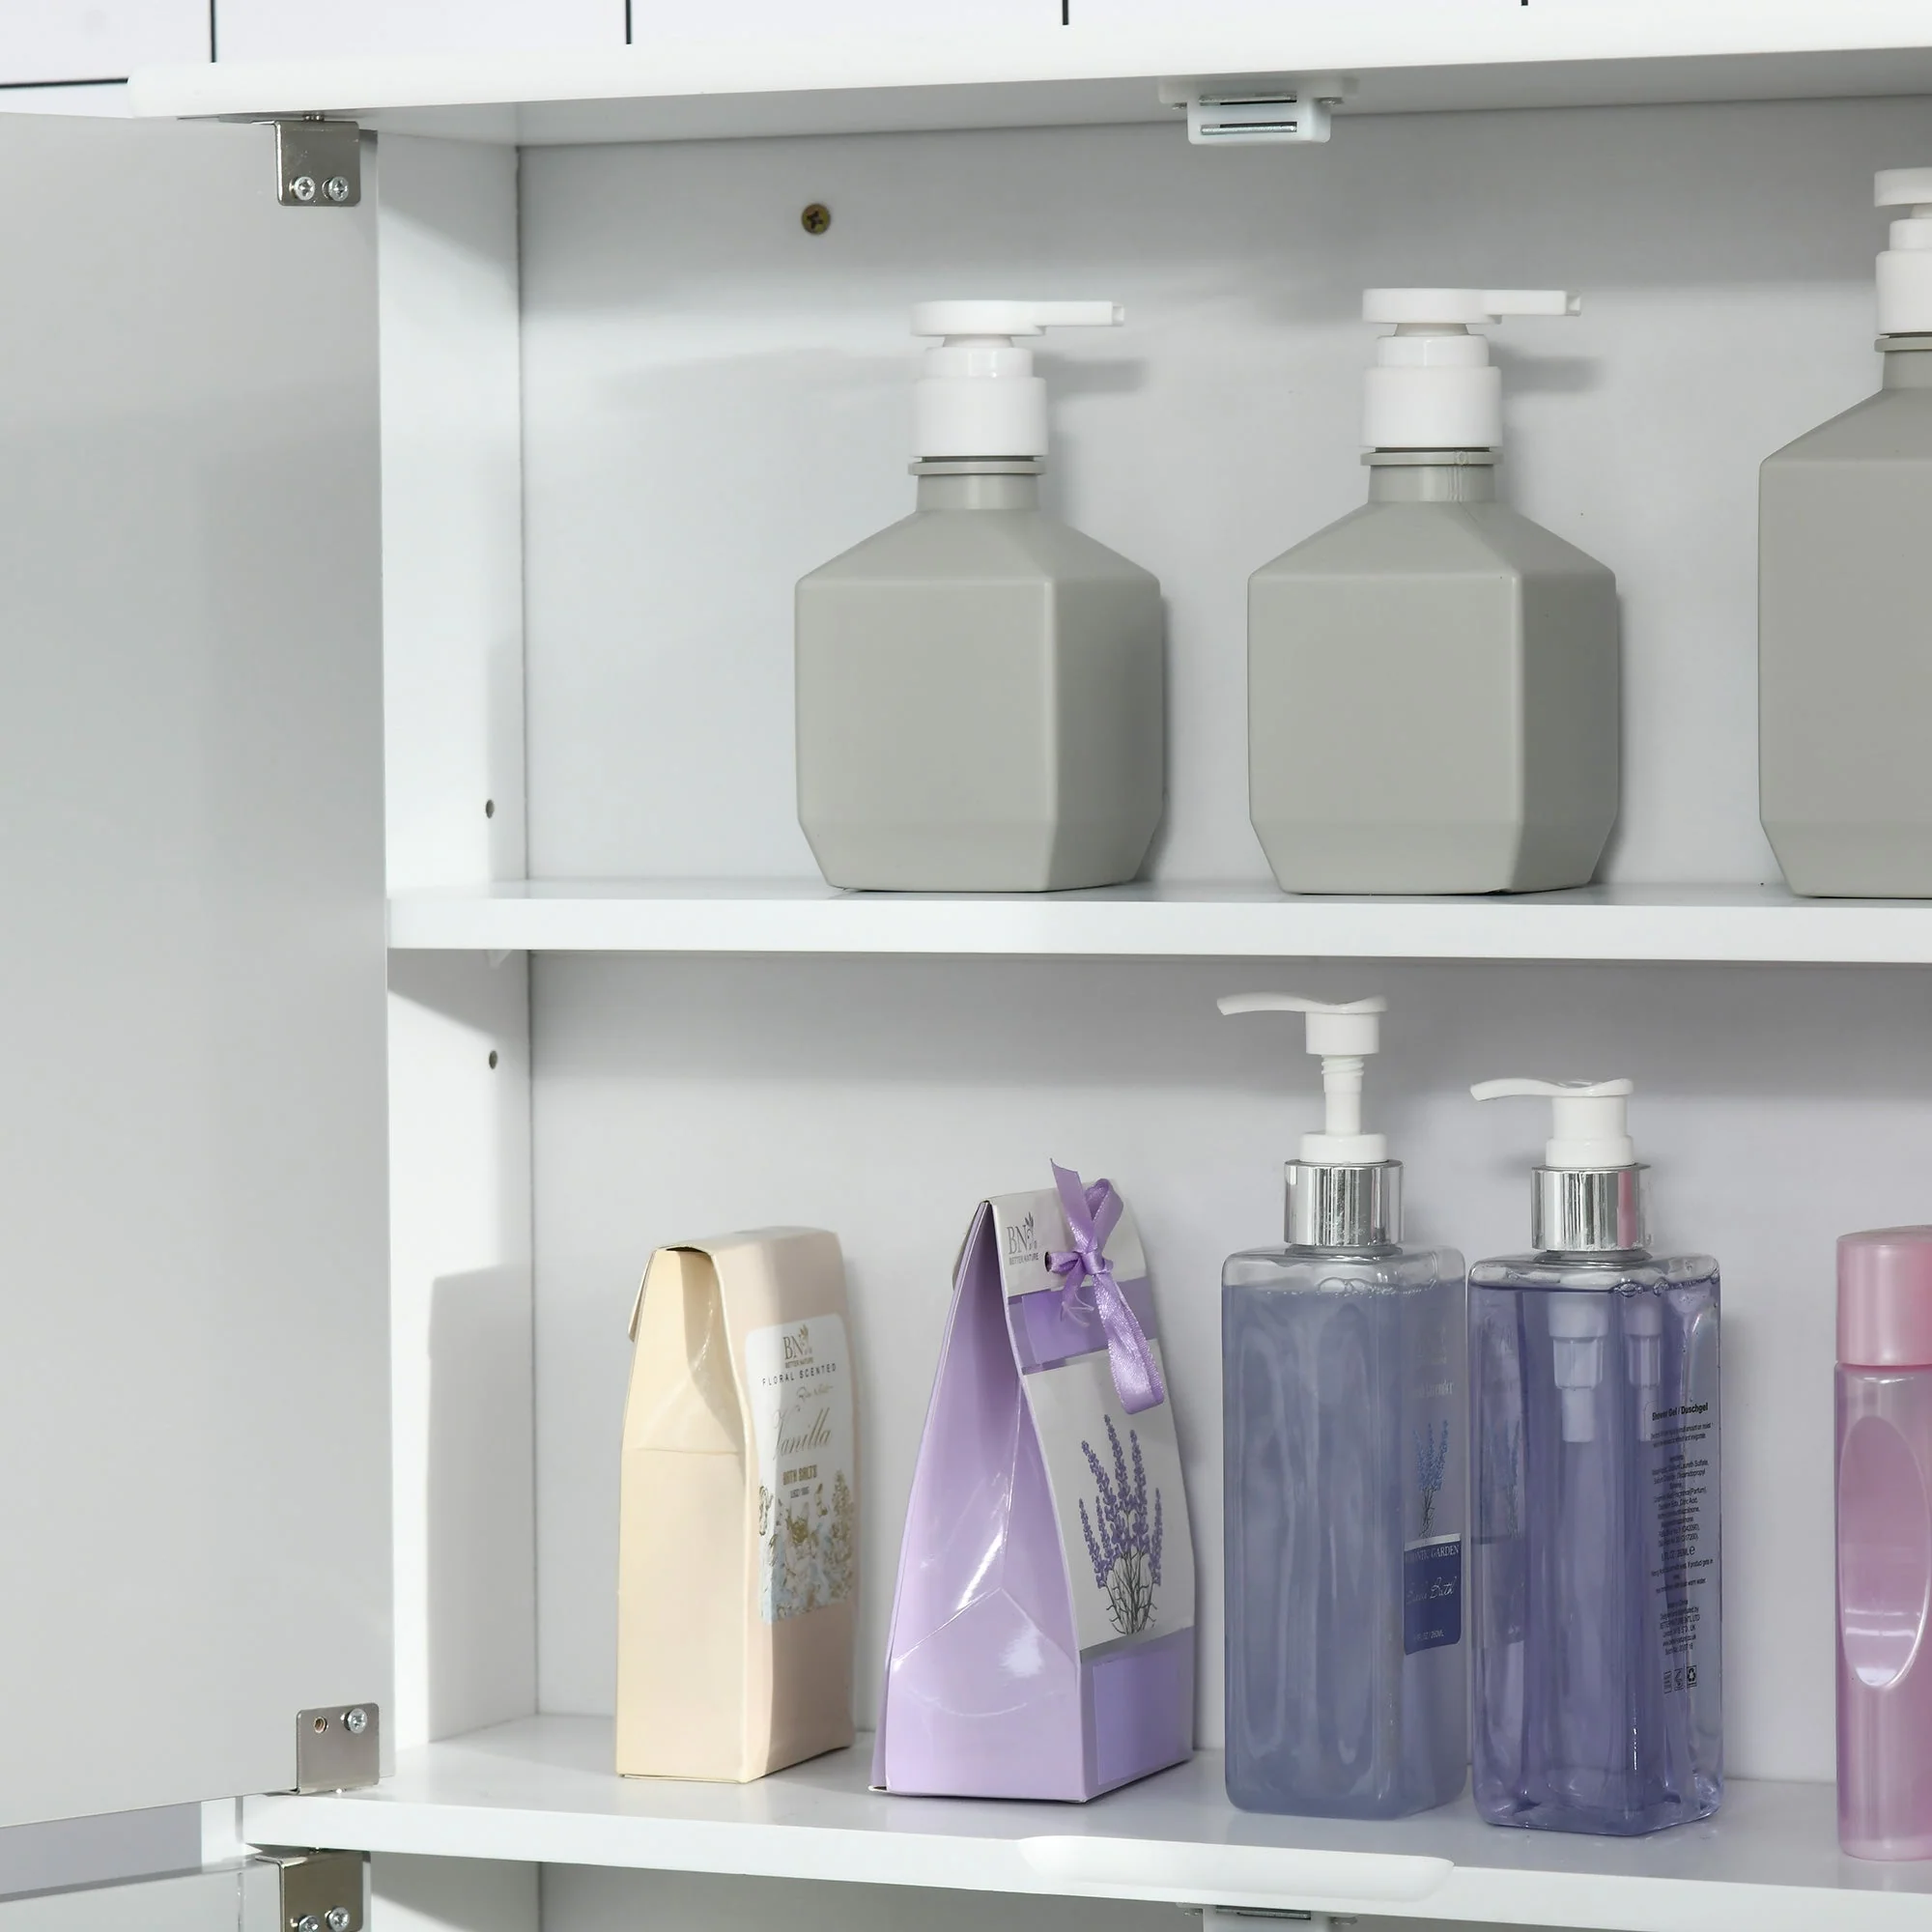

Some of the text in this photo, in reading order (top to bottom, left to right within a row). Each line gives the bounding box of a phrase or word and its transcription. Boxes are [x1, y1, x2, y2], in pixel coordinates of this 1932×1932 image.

[762, 1362, 838, 1386] FLORAL SCENTED
[1668, 1406, 1678, 1417] Gel
[1681, 1402, 1709, 1414] Duschgel
[773, 1406, 833, 1461] Vanilla
[1431, 1544, 1461, 1558] GARDEN
